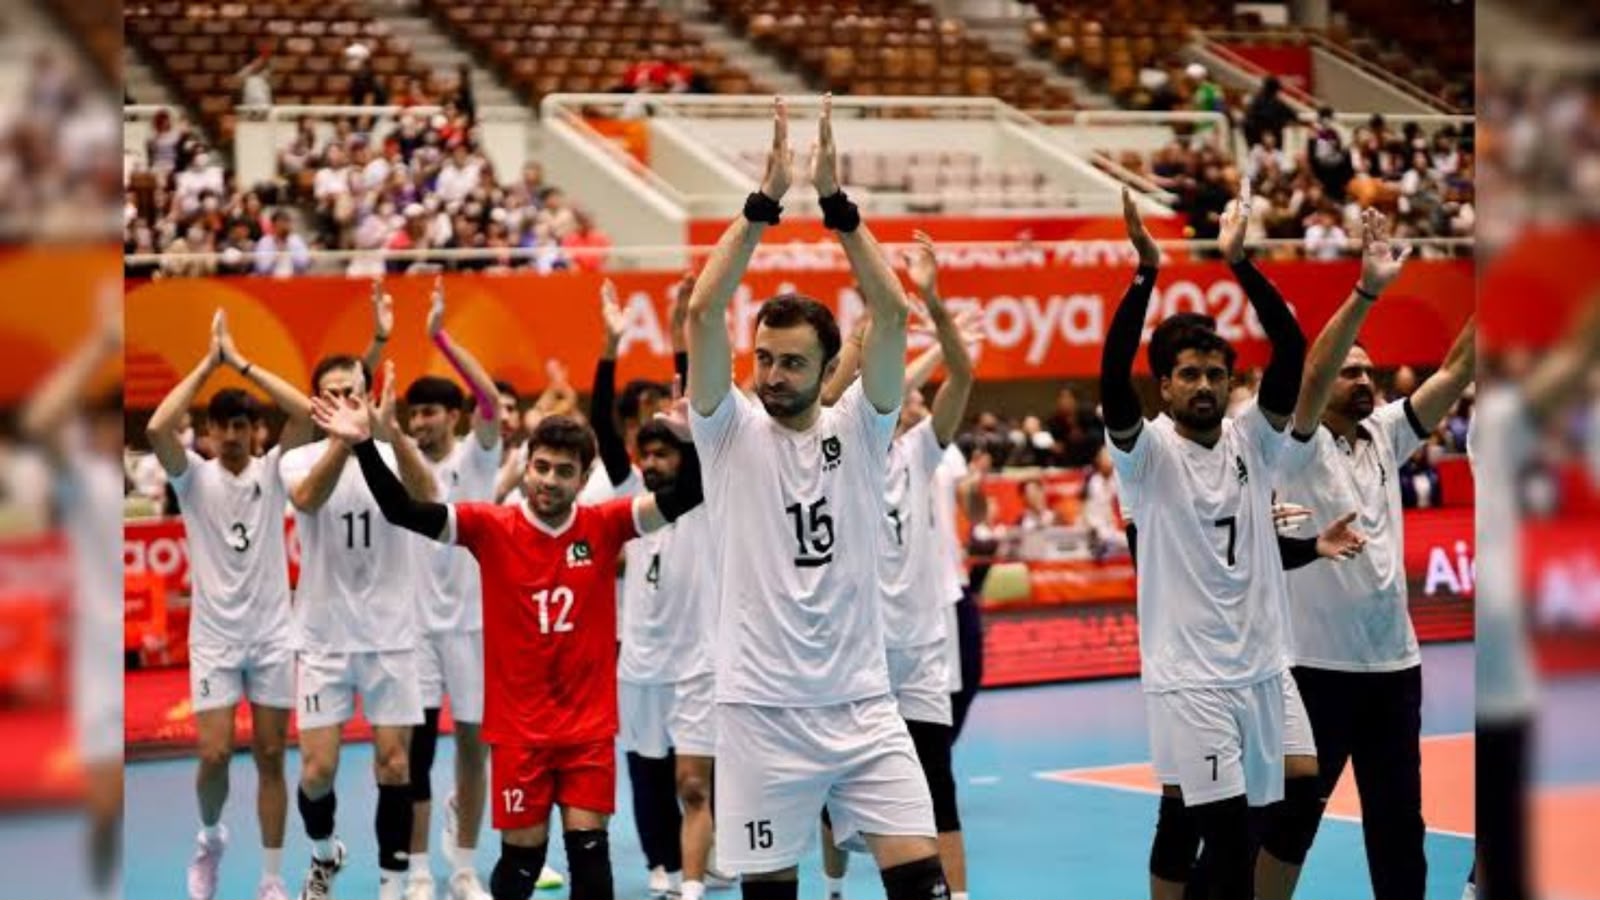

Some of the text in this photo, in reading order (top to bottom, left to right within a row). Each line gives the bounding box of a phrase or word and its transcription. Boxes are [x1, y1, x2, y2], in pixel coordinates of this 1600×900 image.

[232, 522, 249, 552] 3
[341, 509, 371, 548] 11
[786, 496, 834, 554] 15
[1214, 516, 1236, 566] 7
[646, 554, 661, 591] 4
[1425, 540, 1476, 596] Ai
[531, 586, 574, 634] 12
[200, 679, 211, 698] 3
[304, 693, 321, 713] 11
[1204, 754, 1218, 782] 7
[502, 788, 525, 813] 12
[744, 819, 774, 851] 15
